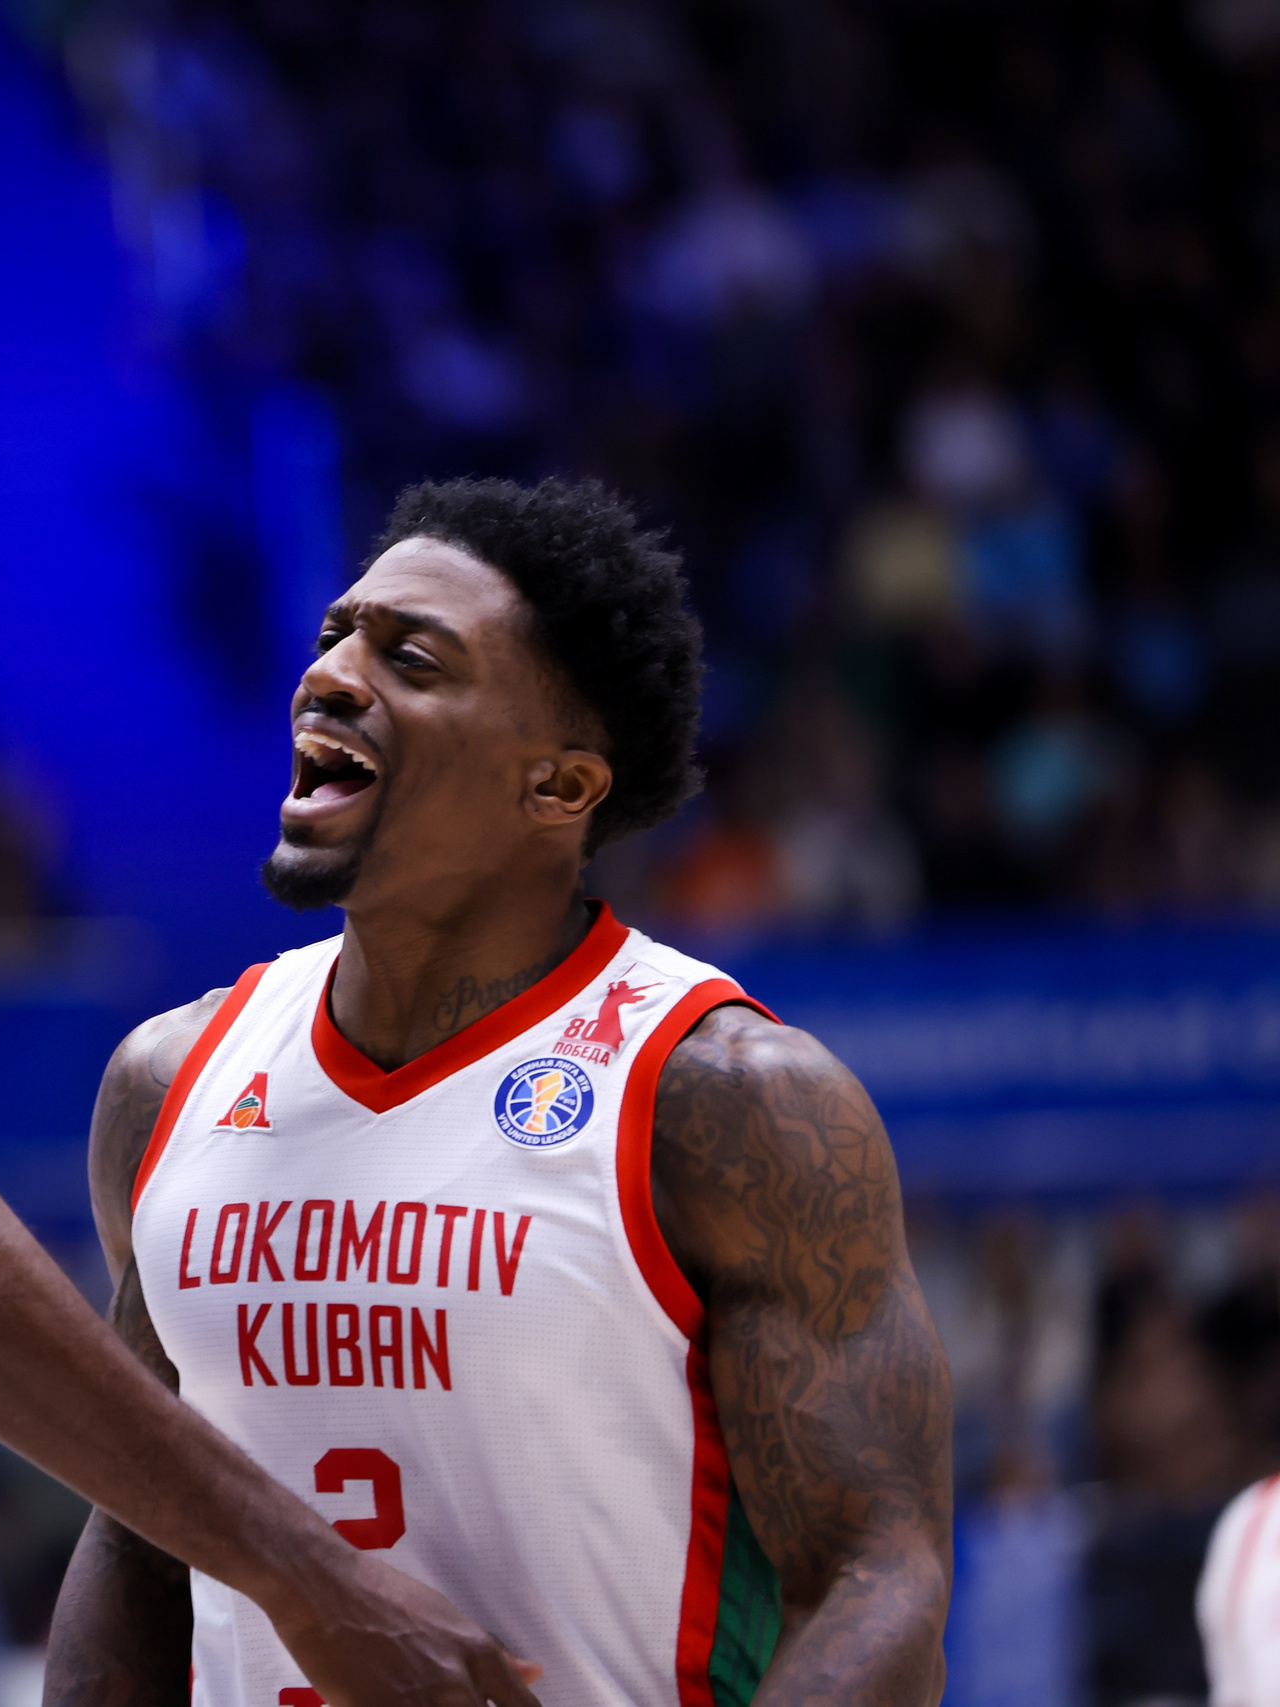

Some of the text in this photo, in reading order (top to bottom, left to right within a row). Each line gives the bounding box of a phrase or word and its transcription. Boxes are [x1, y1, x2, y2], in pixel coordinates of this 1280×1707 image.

[551, 1041, 611, 1067] ПОБЕДА
[510, 1059, 555, 1081] ЕДИНАЯ
[554, 1059, 580, 1077] ЛИГА
[507, 1125, 541, 1145] UNITED
[178, 1199, 532, 1297] LOKOMOTIV
[237, 1302, 452, 1391] KUBAN
